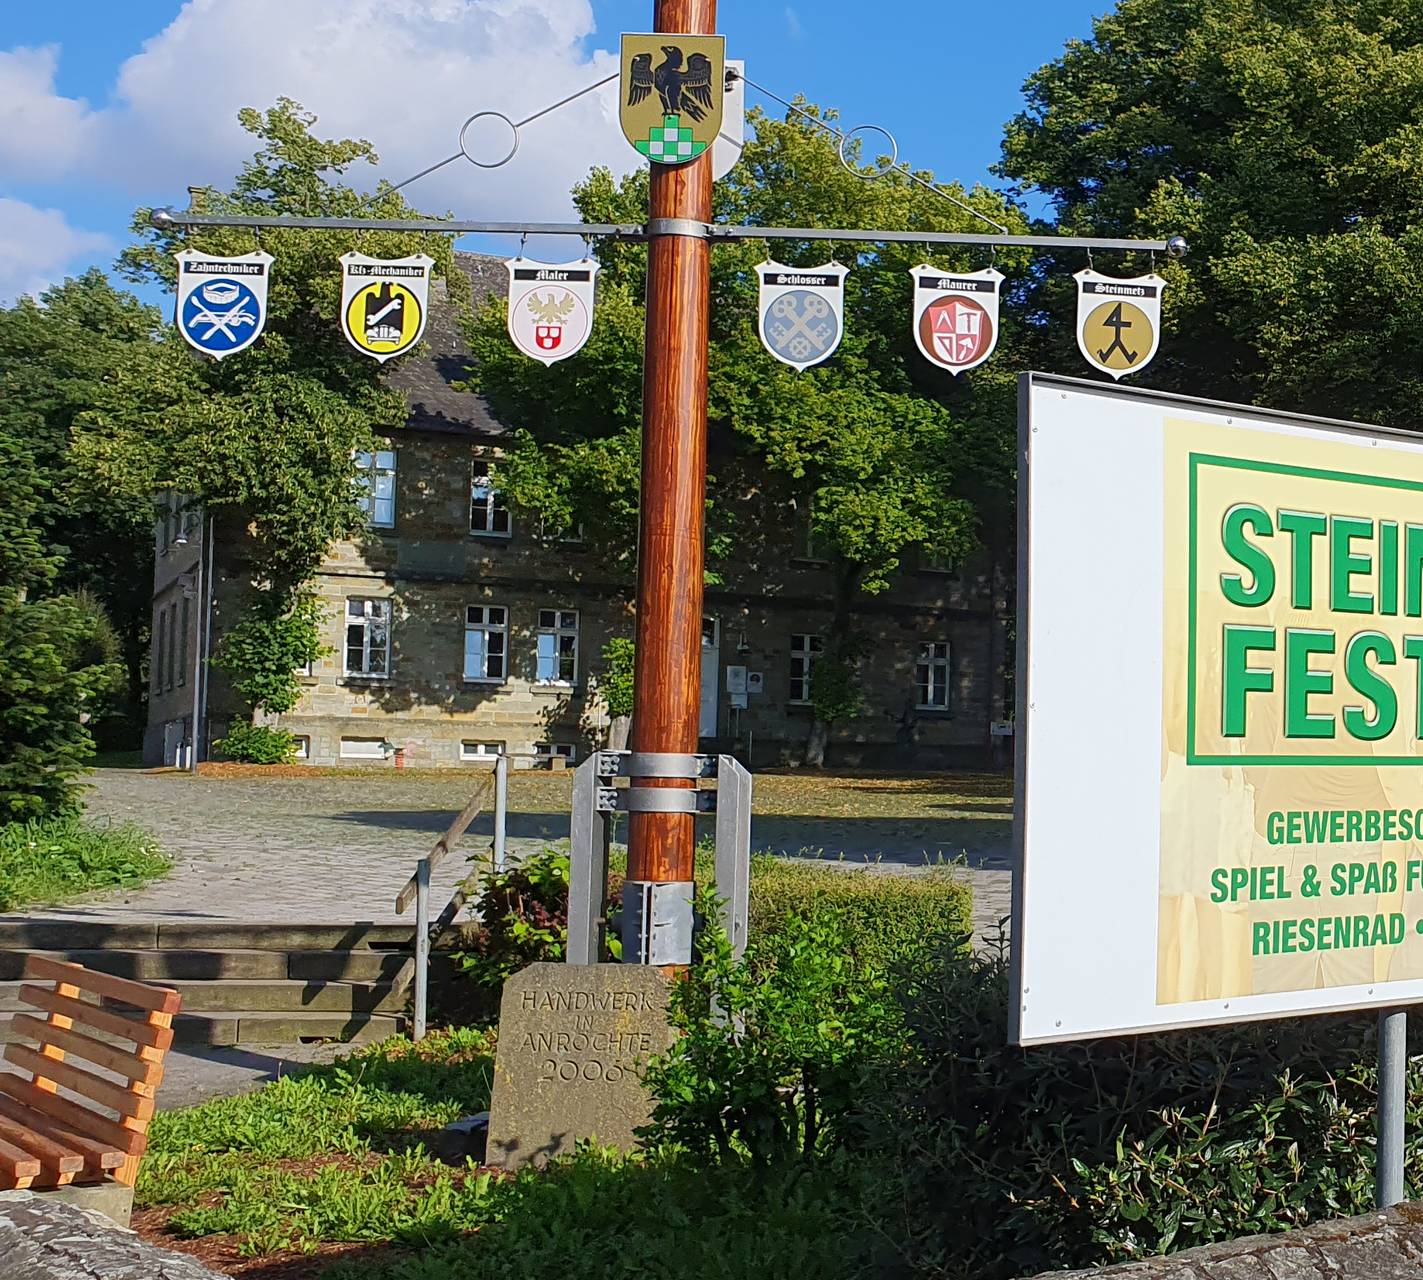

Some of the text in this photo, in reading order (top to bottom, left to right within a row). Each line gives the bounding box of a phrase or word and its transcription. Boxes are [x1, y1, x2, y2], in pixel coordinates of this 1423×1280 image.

[189, 262, 260, 275] Zahntechniker
[349, 264, 424, 276] Kfz-Mechaniker
[536, 269, 569, 282] Maler
[776, 273, 827, 287] Schlosser
[937, 278, 978, 292] Maurer
[1094, 283, 1145, 296] Steinmetz
[1210, 865, 1292, 903] SPIEL
[1300, 863, 1322, 897] &
[1252, 912, 1405, 956] RIESENRAD
[520, 990, 654, 1011] HANDWERK
[575, 1015, 594, 1030] IN
[541, 1058, 624, 1082] 2006
